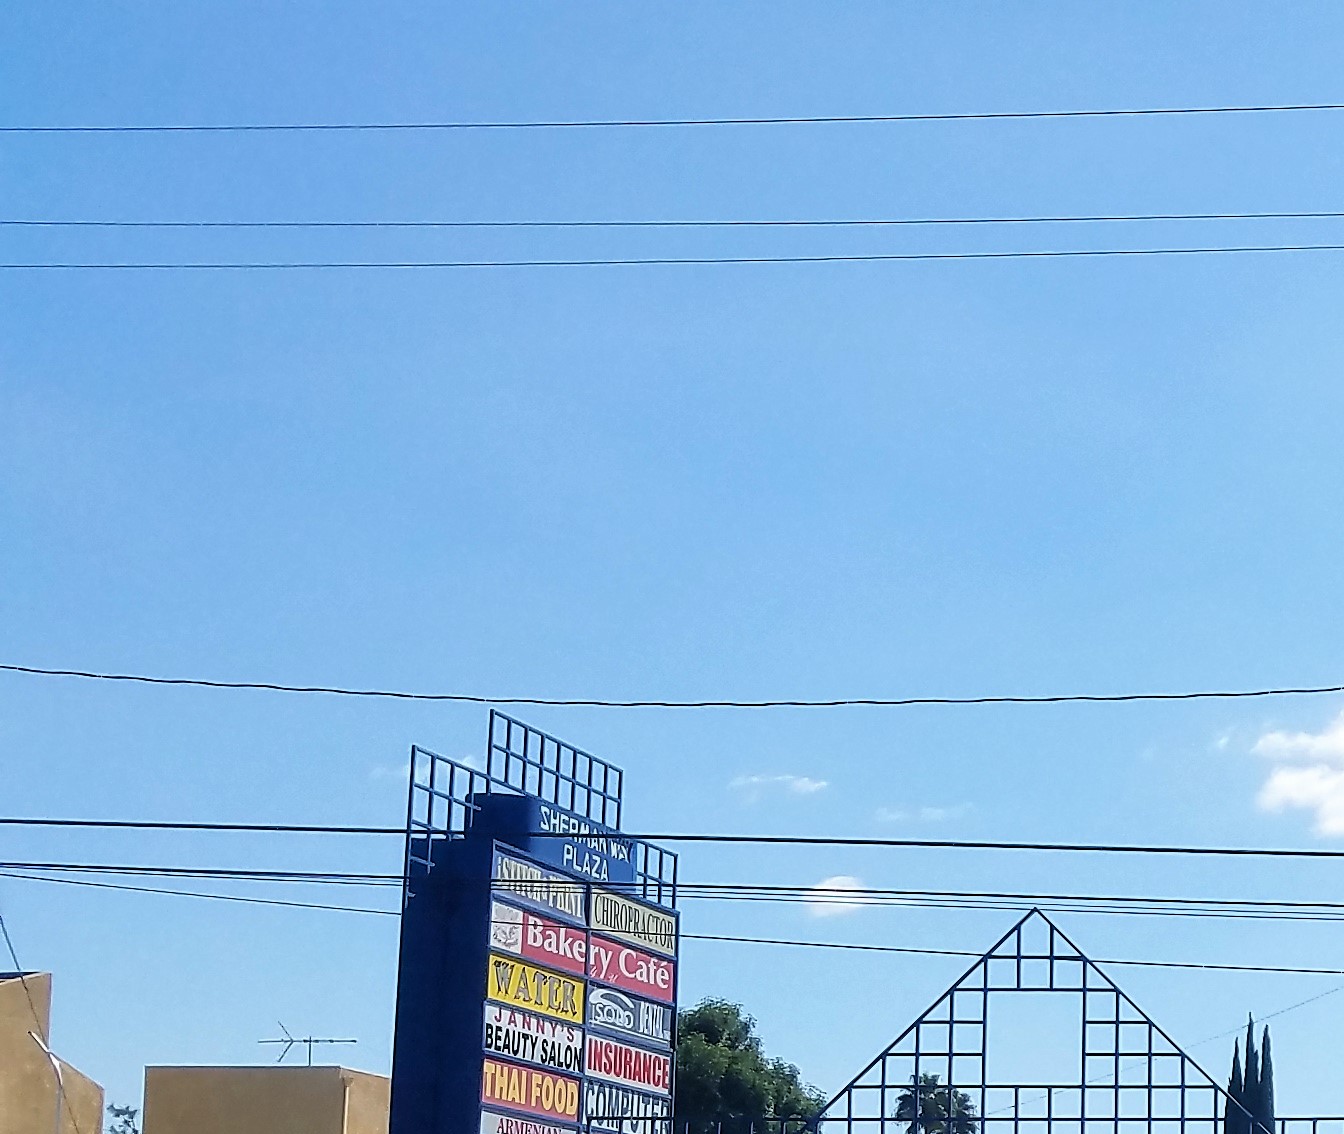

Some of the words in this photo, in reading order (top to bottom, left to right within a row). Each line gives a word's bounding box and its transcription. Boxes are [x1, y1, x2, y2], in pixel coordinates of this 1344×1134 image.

[563, 844, 609, 882] PLAZA
[594, 894, 674, 950] CHIROPRACTOR
[527, 916, 613, 979] Bakery
[619, 949, 670, 989] Café
[493, 960, 578, 1017] WATER
[485, 1023, 539, 1060] BEAUTY
[540, 1039, 583, 1072] SALON
[494, 1007, 576, 1042] JANNY'S
[484, 1062, 527, 1105] THAI
[531, 1072, 579, 1115] FOOD
[587, 1038, 670, 1090] INSURANCE
